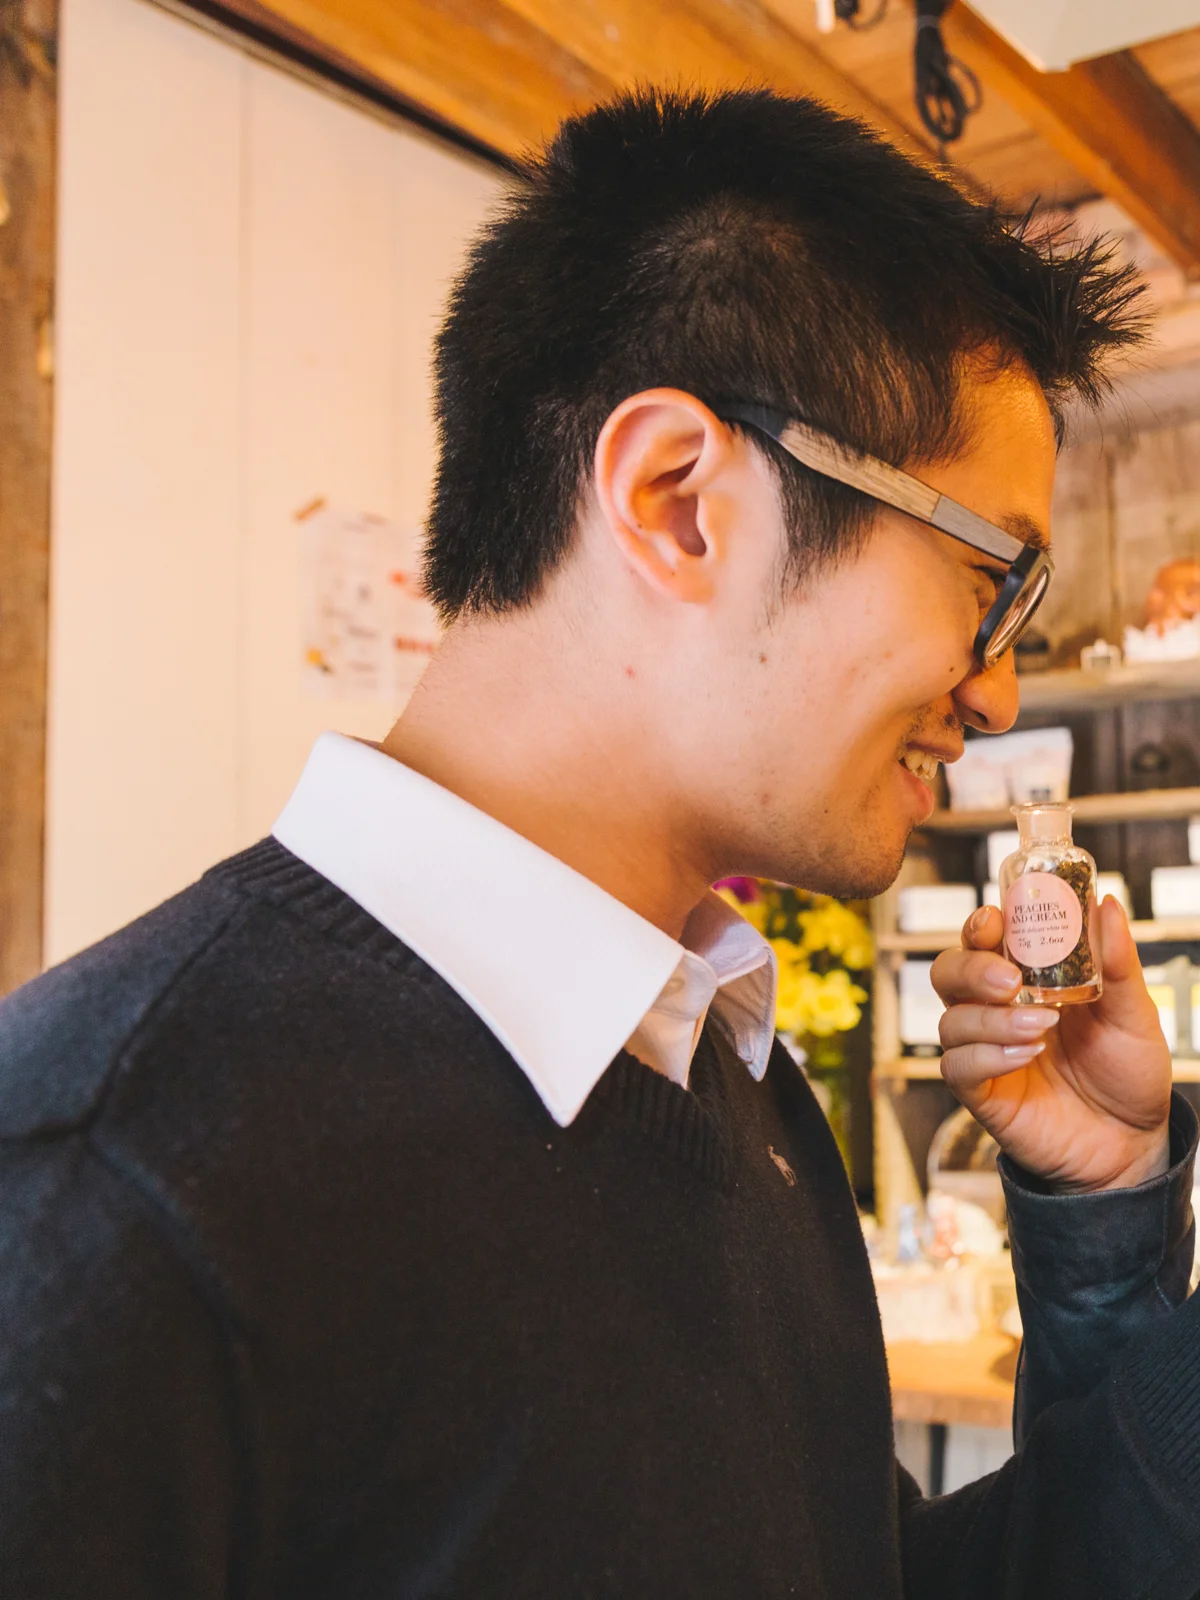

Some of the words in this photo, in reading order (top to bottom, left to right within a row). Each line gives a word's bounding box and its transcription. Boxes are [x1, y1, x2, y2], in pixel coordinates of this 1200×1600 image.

[1014, 902, 1060, 914] PEACHES
[1011, 914, 1028, 924] AND
[1030, 911, 1067, 922] CREAM
[1018, 938, 1031, 949] 75g
[1040, 936, 1064, 945] 2.6oz
